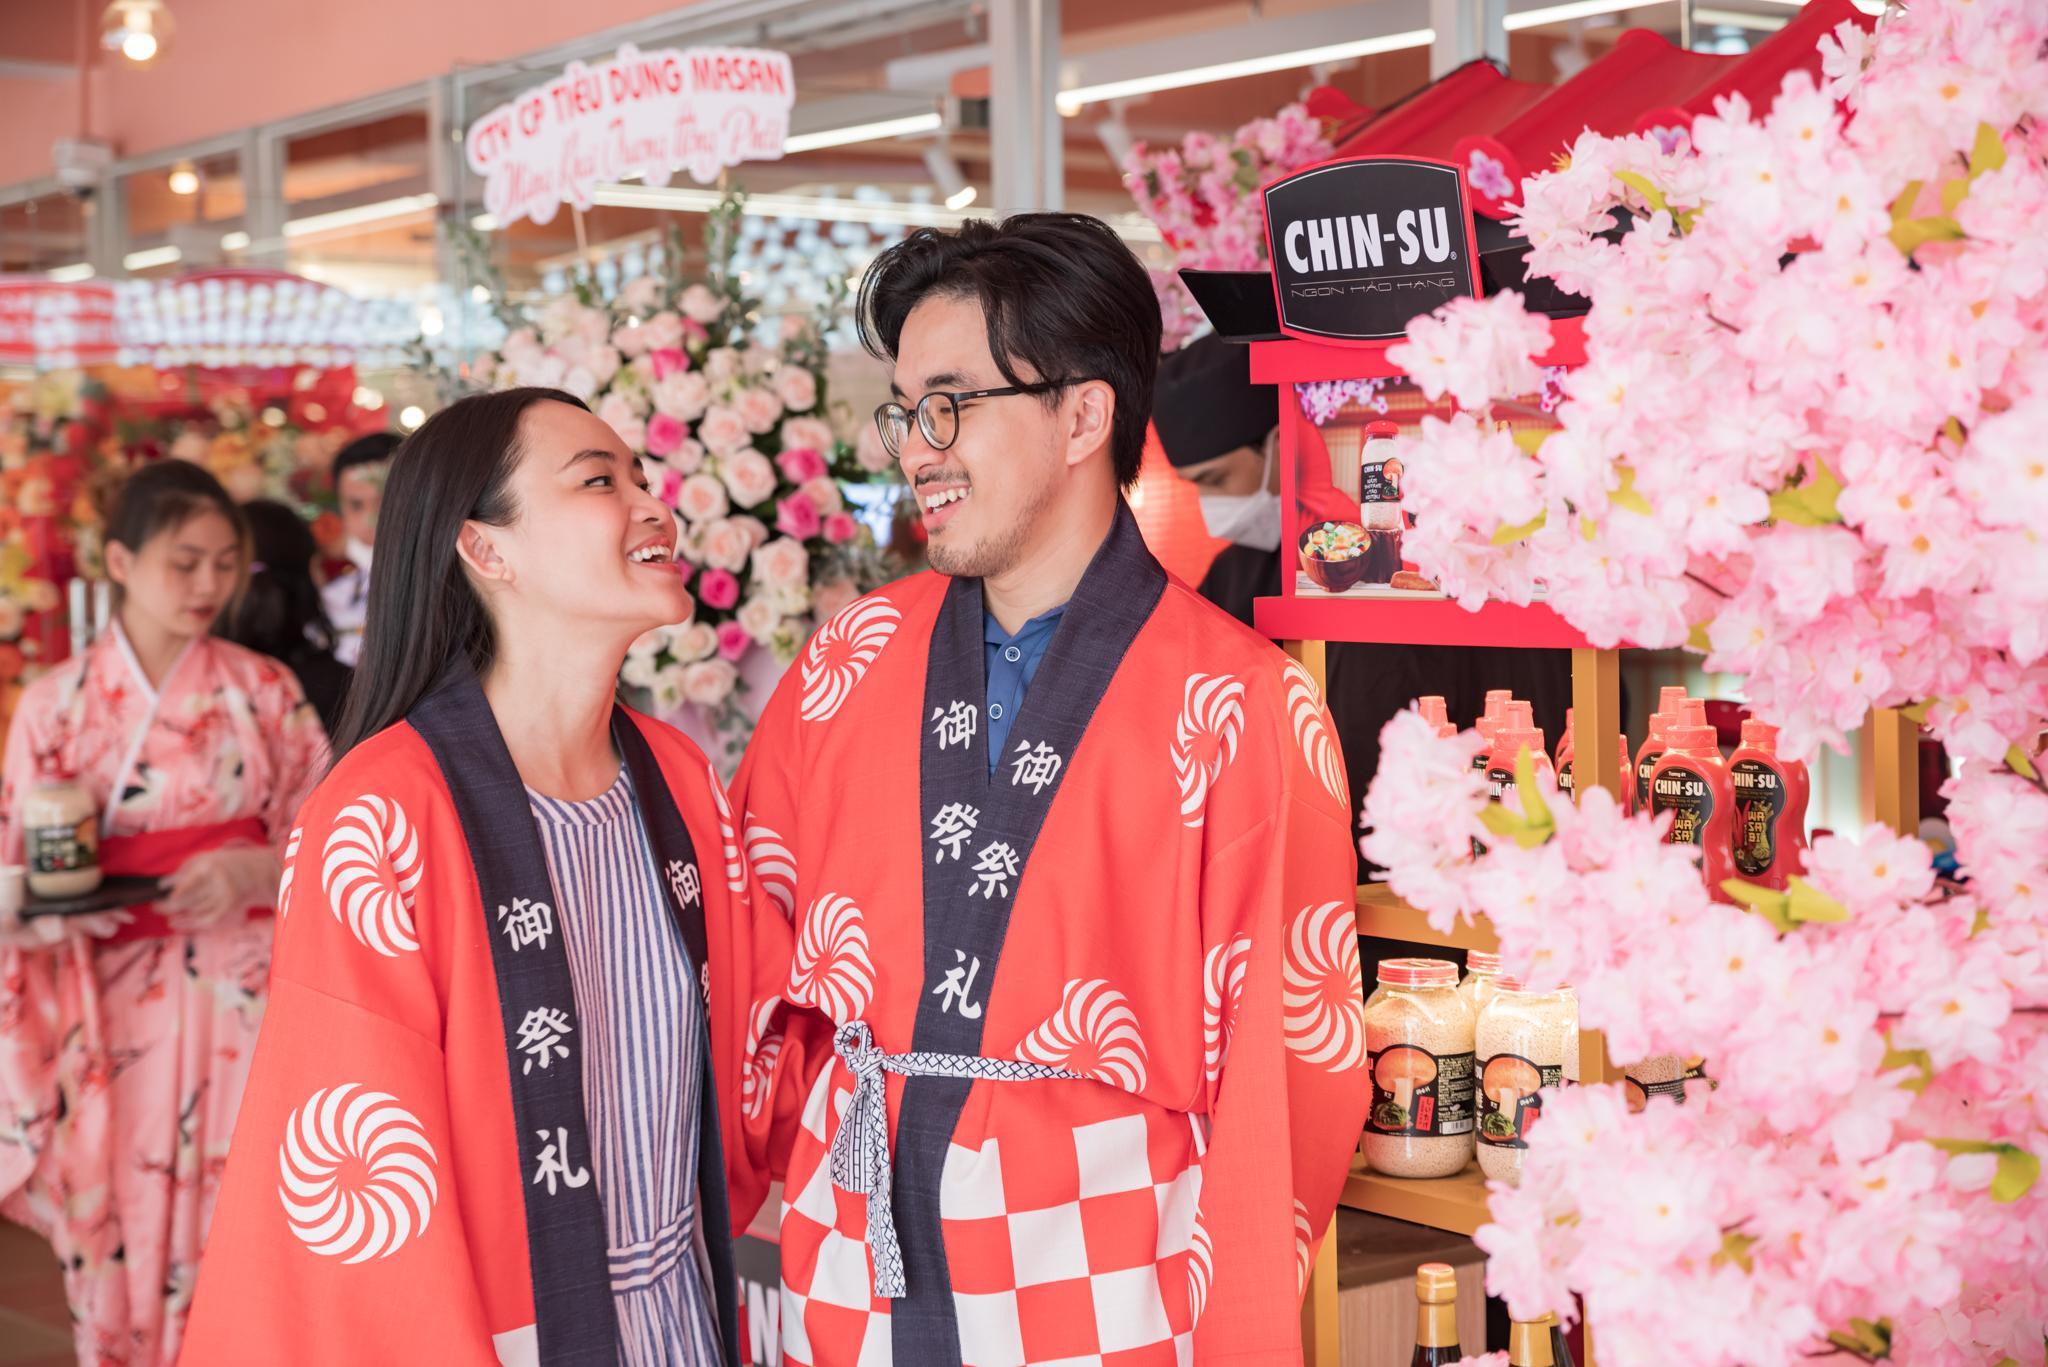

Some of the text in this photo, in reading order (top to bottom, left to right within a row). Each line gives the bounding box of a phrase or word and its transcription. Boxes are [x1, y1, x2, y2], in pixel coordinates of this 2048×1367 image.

[472, 115, 511, 164] CTY
[517, 98, 544, 138] CP
[690, 56, 786, 96] MASAN
[1284, 207, 1450, 274] CHIN-SU
[1291, 286, 1345, 298] NGON
[1655, 779, 1704, 796] CHIN-SU
[1748, 811, 1765, 821] WA
[1675, 819, 1693, 830] WA
[1748, 822, 1762, 831] SA
[1749, 833, 1761, 843] BI
